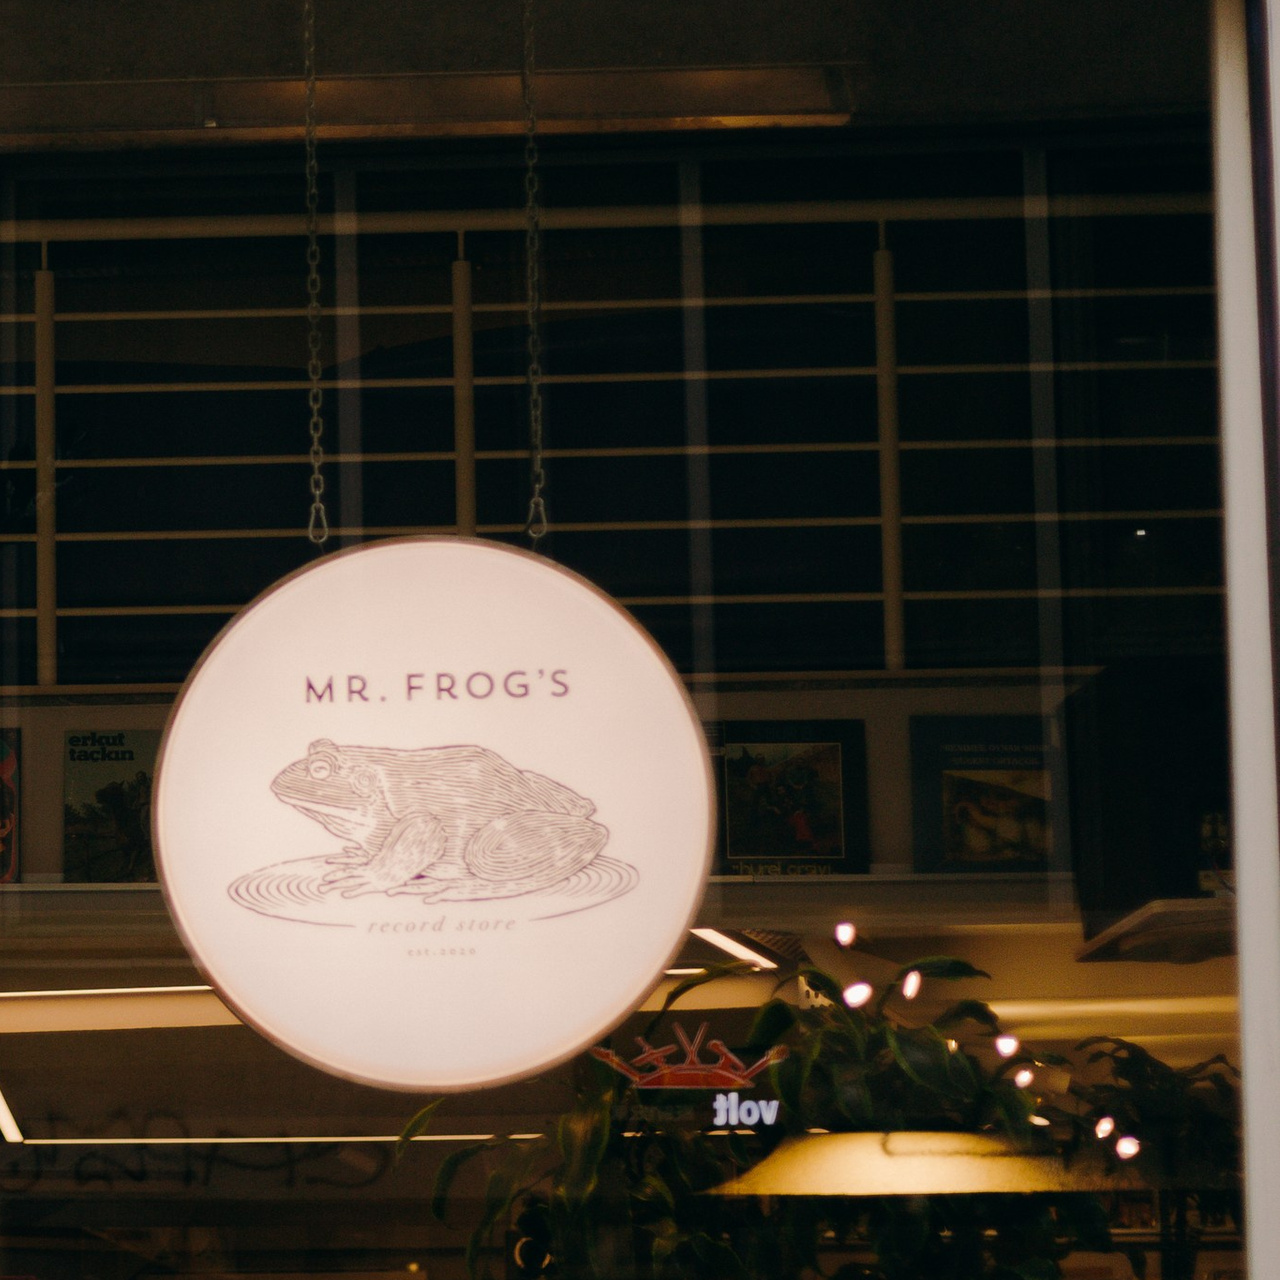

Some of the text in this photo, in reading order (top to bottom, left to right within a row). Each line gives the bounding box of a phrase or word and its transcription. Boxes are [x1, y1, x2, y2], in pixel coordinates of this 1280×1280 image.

[304, 669, 572, 704] MR. FROG'S
[68, 732, 126, 747] erkut
[367, 914, 517, 935] record store
